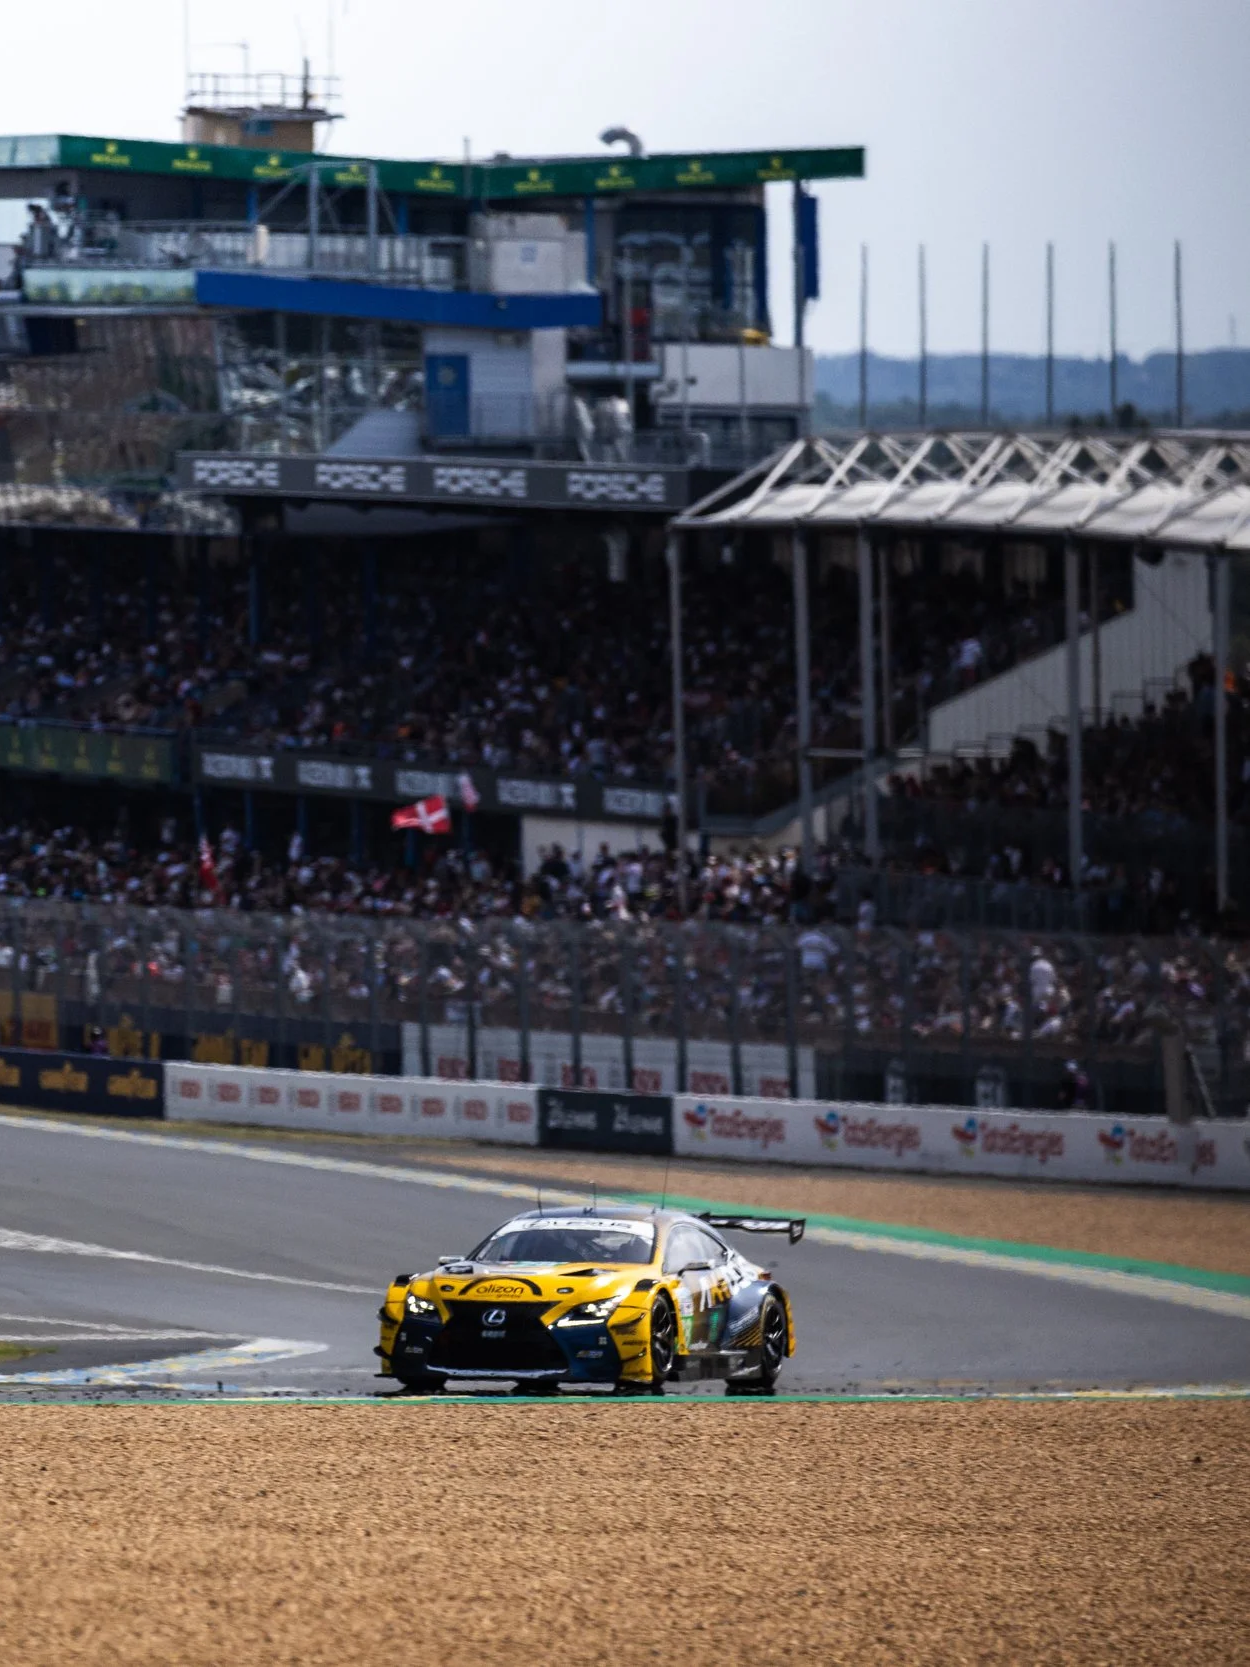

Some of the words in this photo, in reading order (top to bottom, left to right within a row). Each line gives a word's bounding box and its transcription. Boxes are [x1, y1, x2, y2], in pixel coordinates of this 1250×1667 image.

[193, 458, 280, 489] PORSCHE
[315, 462, 406, 492] PORSCHE
[433, 466, 527, 498] PORSCHE
[566, 470, 665, 501] PORSCHE
